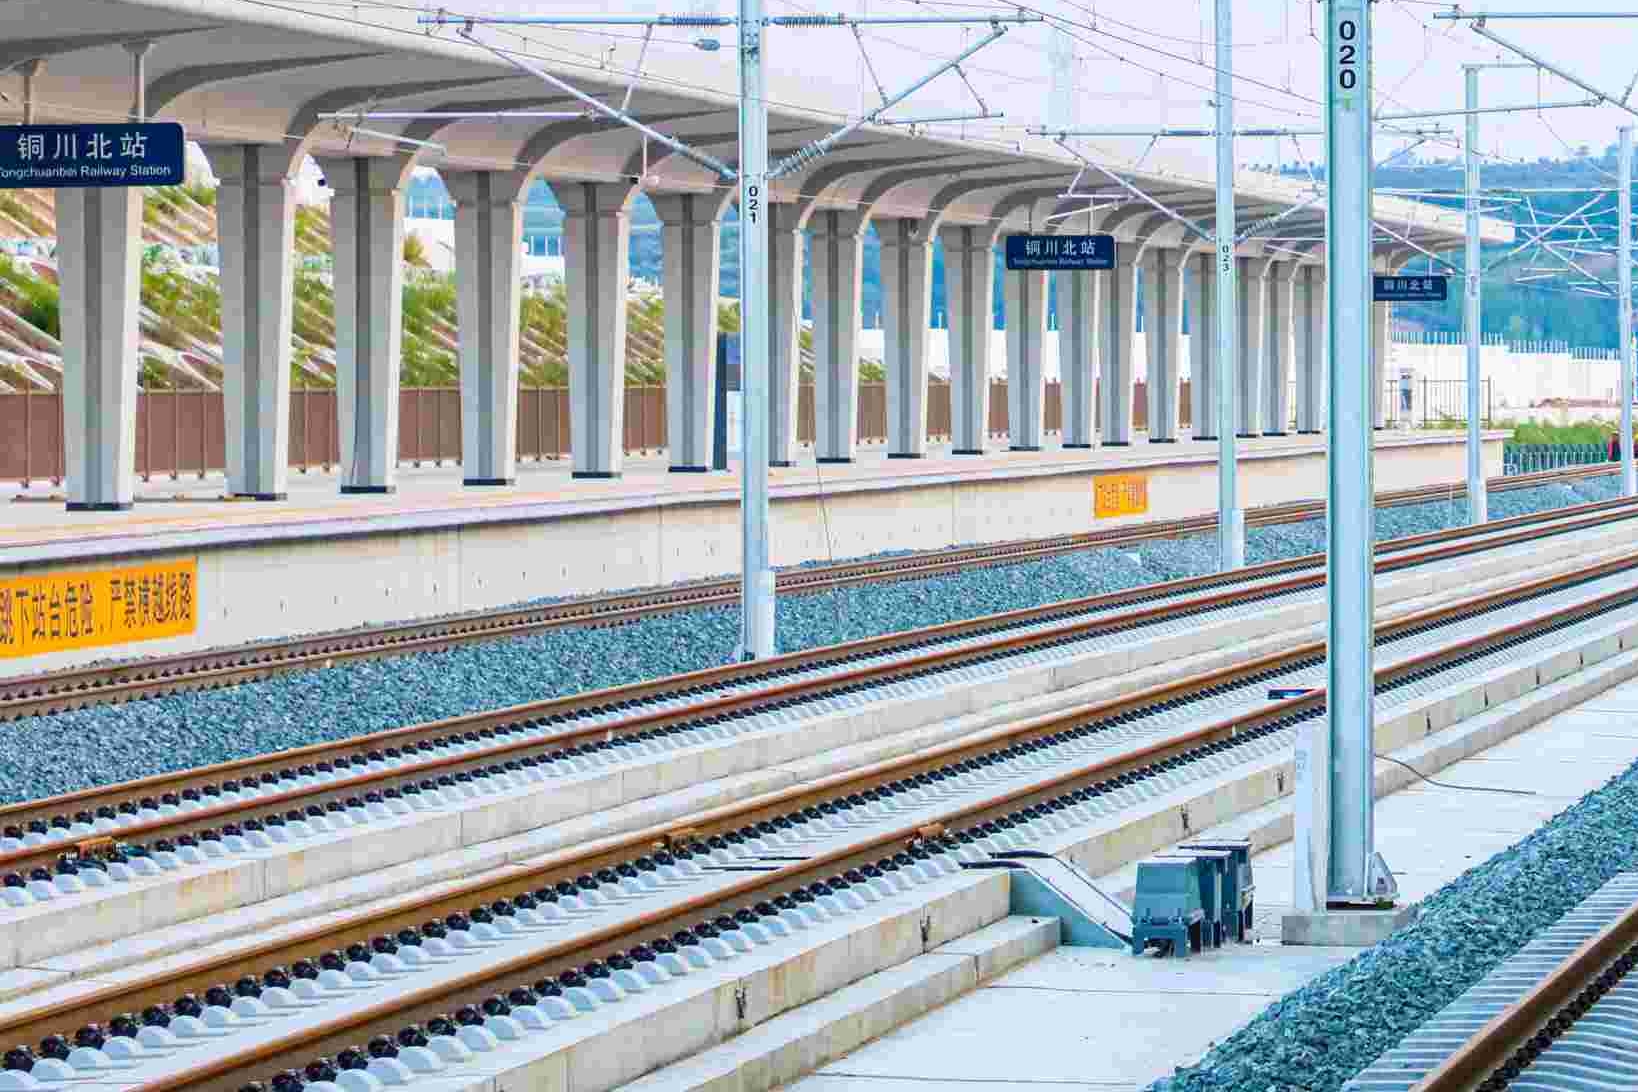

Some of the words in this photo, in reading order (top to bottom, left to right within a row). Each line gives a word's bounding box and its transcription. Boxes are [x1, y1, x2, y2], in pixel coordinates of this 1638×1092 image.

[1338, 19, 1357, 89] 020
[16, 131, 148, 160] 铜川北站
[0, 166, 76, 180] ongchuanbei
[80, 165, 127, 179] Railway
[130, 163, 172, 176] Station
[748, 186, 759, 225] 021
[1025, 238, 1096, 256] 铜川北站
